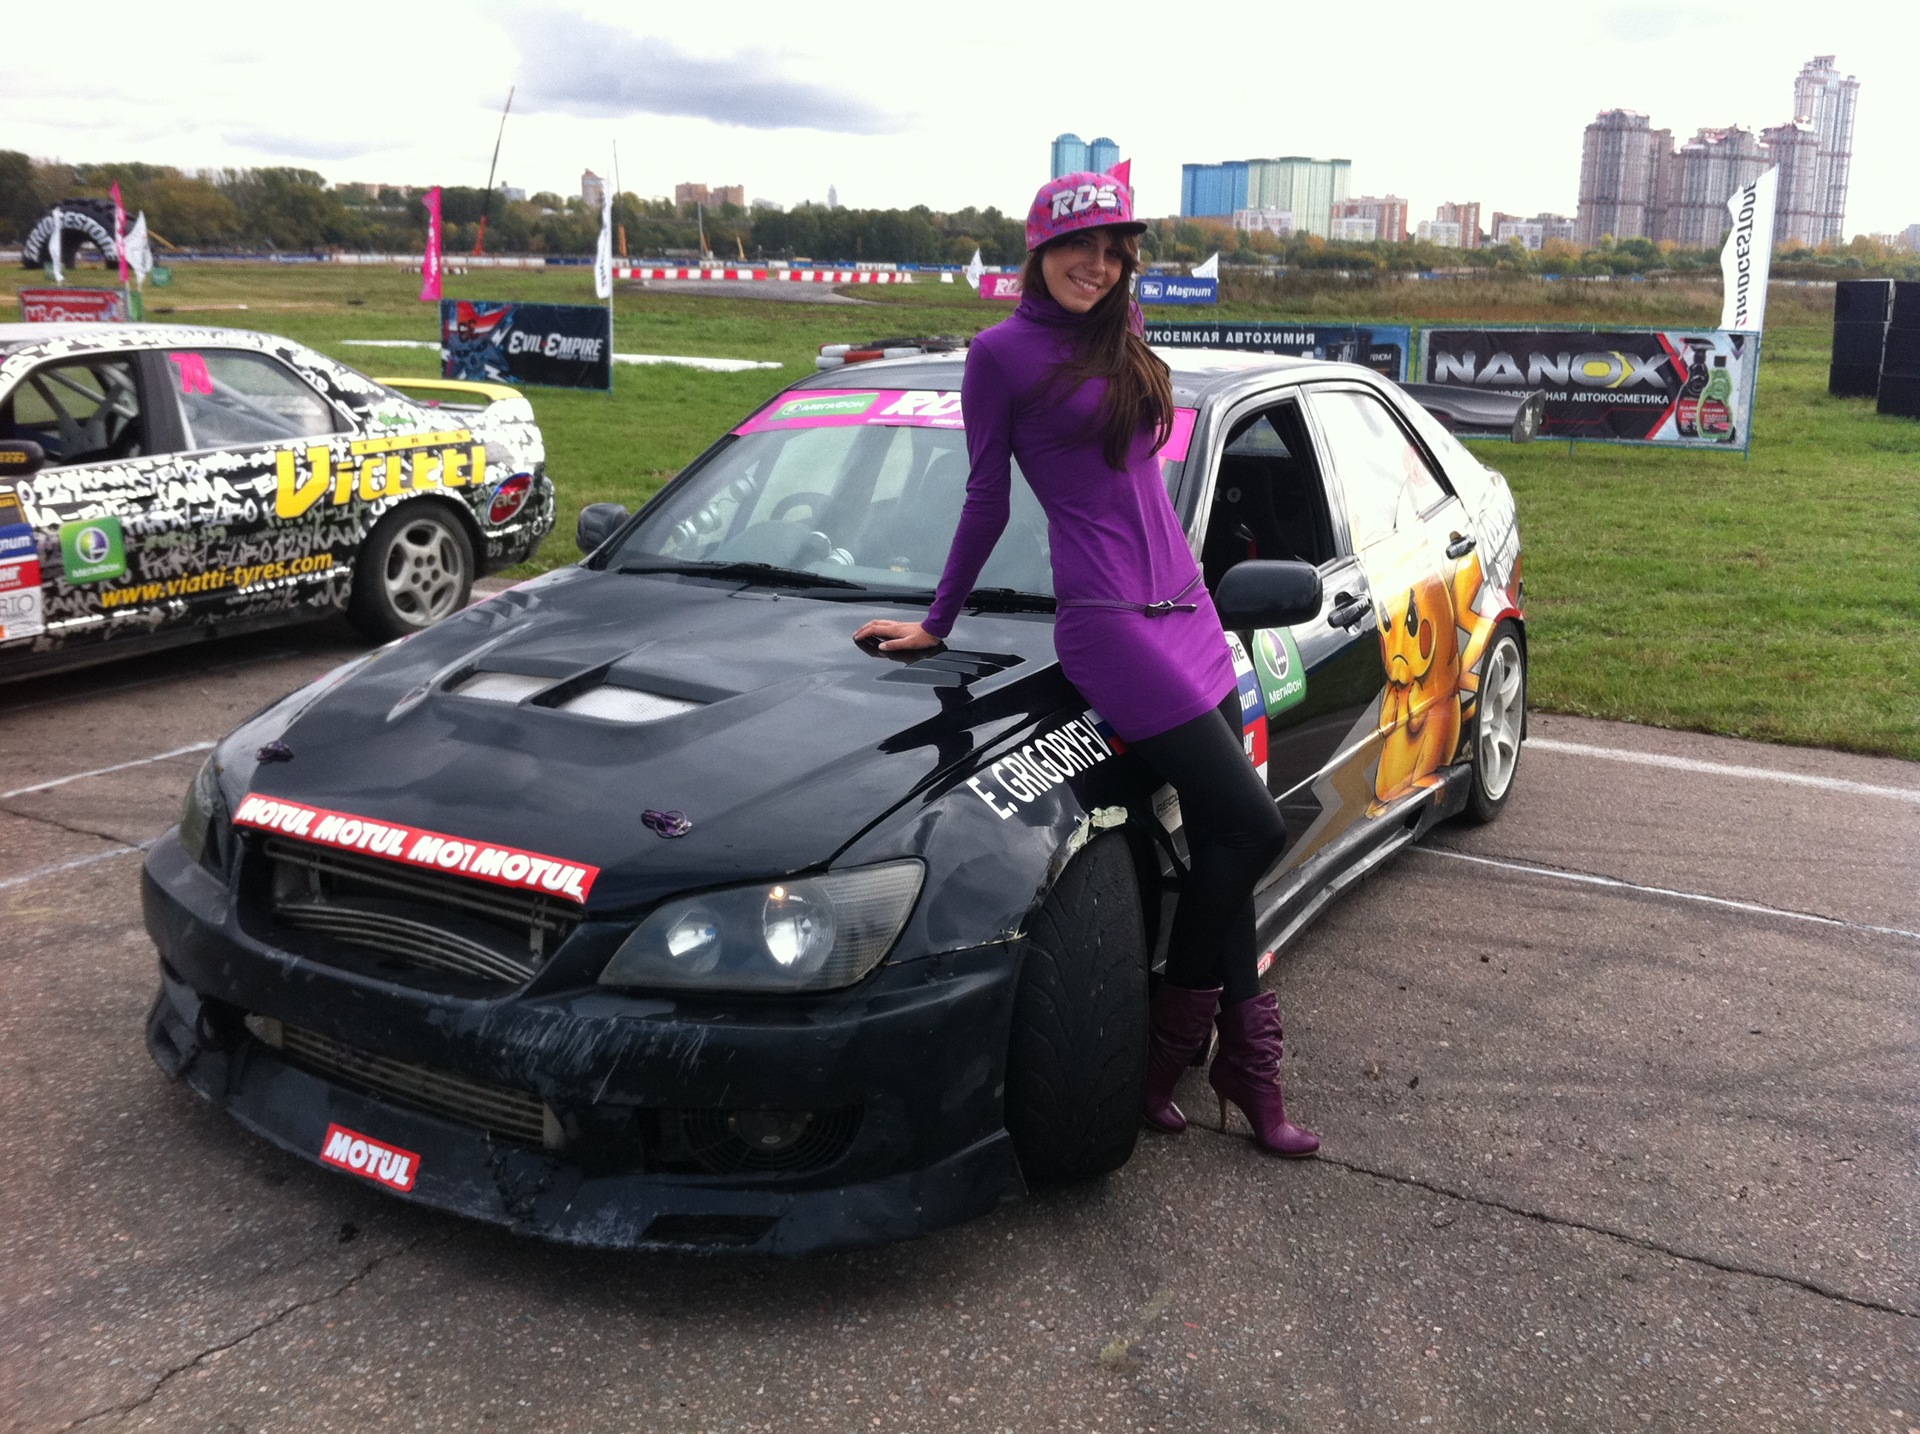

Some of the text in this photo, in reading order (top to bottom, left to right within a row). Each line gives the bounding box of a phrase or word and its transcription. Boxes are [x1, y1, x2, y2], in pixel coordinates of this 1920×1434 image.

[1051, 184, 1118, 221] RDS
[1166, 284, 1212, 299] Magnum
[1145, 330, 1315, 345] УКОЕМКАЯ АВТОХИМИЯ
[1435, 351, 1671, 389] NANOX
[1572, 392, 1670, 405] АВТОКОСМЕТИКА
[362, 434, 464, 451] TYRES
[101, 553, 333, 609] www.viatti-tyres.com
[966, 715, 1113, 820] E. GRIGORYEV
[238, 797, 316, 836] MOTUL
[312, 815, 409, 858] MOTUL
[469, 847, 587, 899] MOTUL
[324, 1131, 411, 1187] MOTUL
